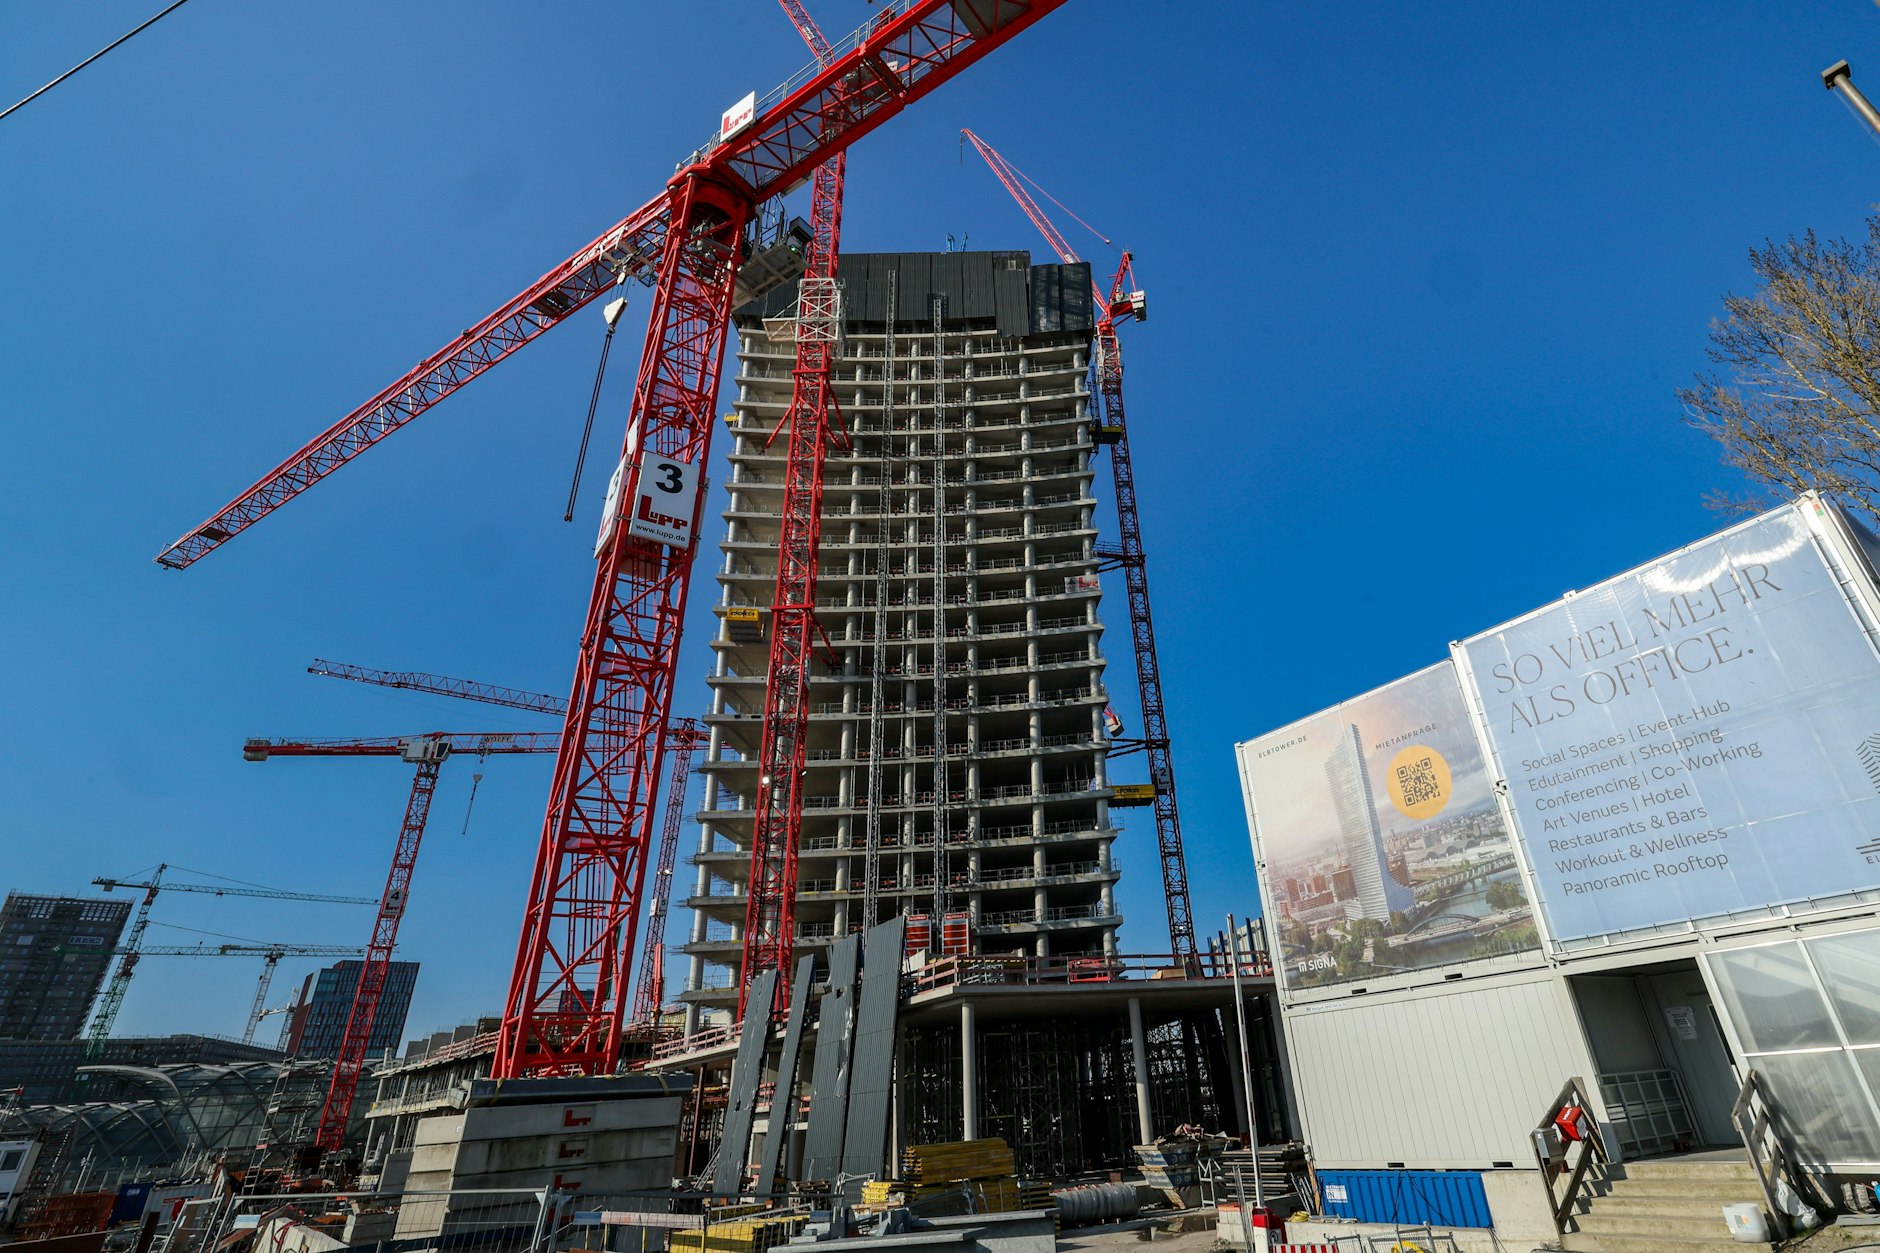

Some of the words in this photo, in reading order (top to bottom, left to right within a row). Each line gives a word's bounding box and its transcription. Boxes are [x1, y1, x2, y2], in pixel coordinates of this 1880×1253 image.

[656, 463, 683, 494] 3
[635, 524, 686, 543] www.lupp.de
[638, 495, 688, 530] Lupp
[1492, 653, 1543, 694] SO
[1548, 620, 1638, 670] VIEL
[1641, 563, 1784, 638] MEHR
[1510, 684, 1576, 734] ALS
[1583, 626, 1754, 705] OFFICE.
[1258, 735, 1308, 759] ELBTOWER.DE
[1375, 722, 1438, 751] MIETANFRAGE
[1521, 748, 1567, 772] Social
[1568, 733, 1626, 759] Spaces
[1637, 699, 1731, 738] Event-Hub
[1528, 754, 1628, 792] Edutainment
[1639, 727, 1724, 760] Shopping
[1535, 775, 1641, 811] Conferencing
[1651, 741, 1763, 780] Co-Working
[1543, 815, 1568, 833] Art
[1569, 801, 1630, 825] Venues
[1640, 782, 1691, 807] Hotel
[1548, 821, 1647, 853] Restaurants
[1650, 815, 1665, 829] &
[1666, 806, 1708, 826] Bars
[1554, 848, 1627, 874] Workout
[1629, 844, 1645, 859] &
[1644, 827, 1728, 855] Wellness
[390, 891, 400, 901] 4
[1562, 868, 1651, 896] Panoramic
[1653, 853, 1729, 878] Rooftop
[1308, 956, 1338, 971] SIGNA
